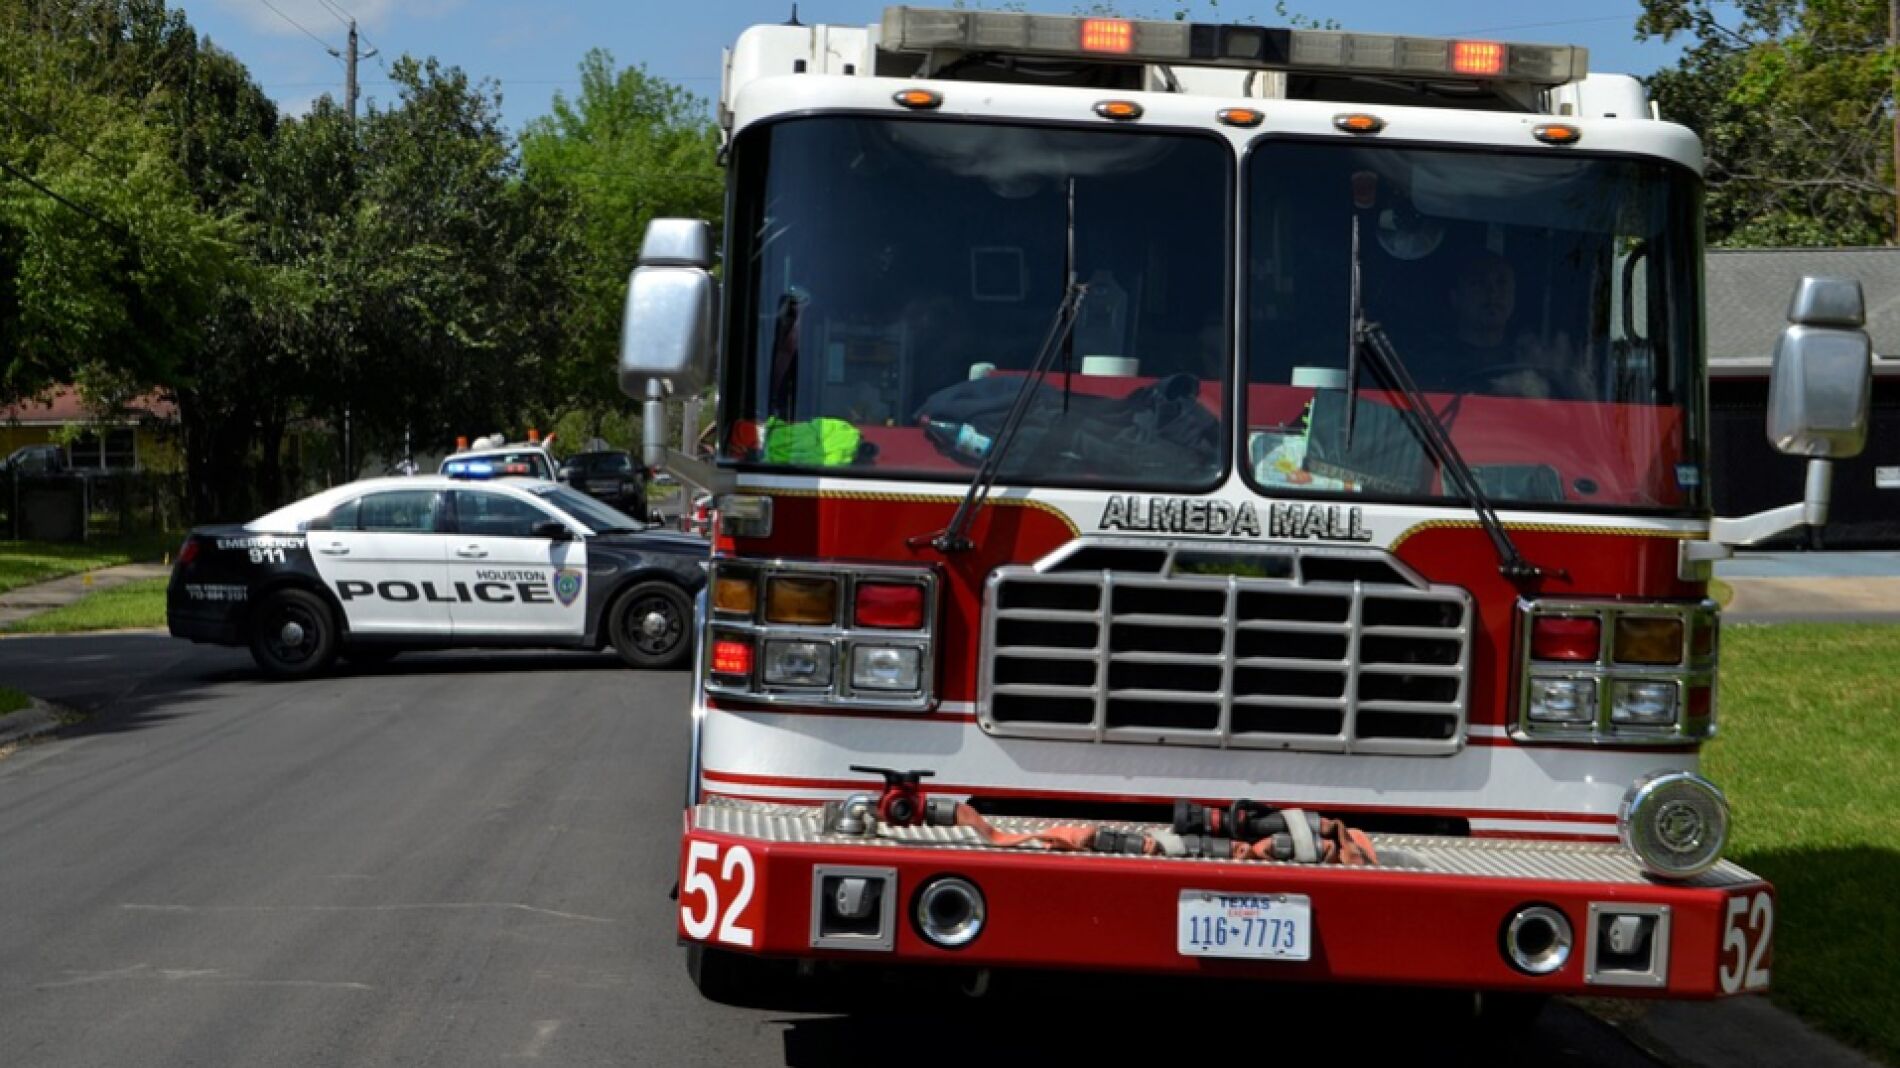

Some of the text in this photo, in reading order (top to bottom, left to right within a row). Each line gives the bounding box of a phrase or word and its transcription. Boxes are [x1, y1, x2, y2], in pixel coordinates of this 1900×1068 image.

[1098, 494, 1373, 542] ALMEDA MALL
[249, 547, 286, 564] 911
[476, 569, 547, 581] HOUSTON
[335, 579, 554, 604] POLICE
[681, 839, 755, 947] 52
[1219, 896, 1271, 910] TEXAS
[1719, 891, 1774, 994] 52
